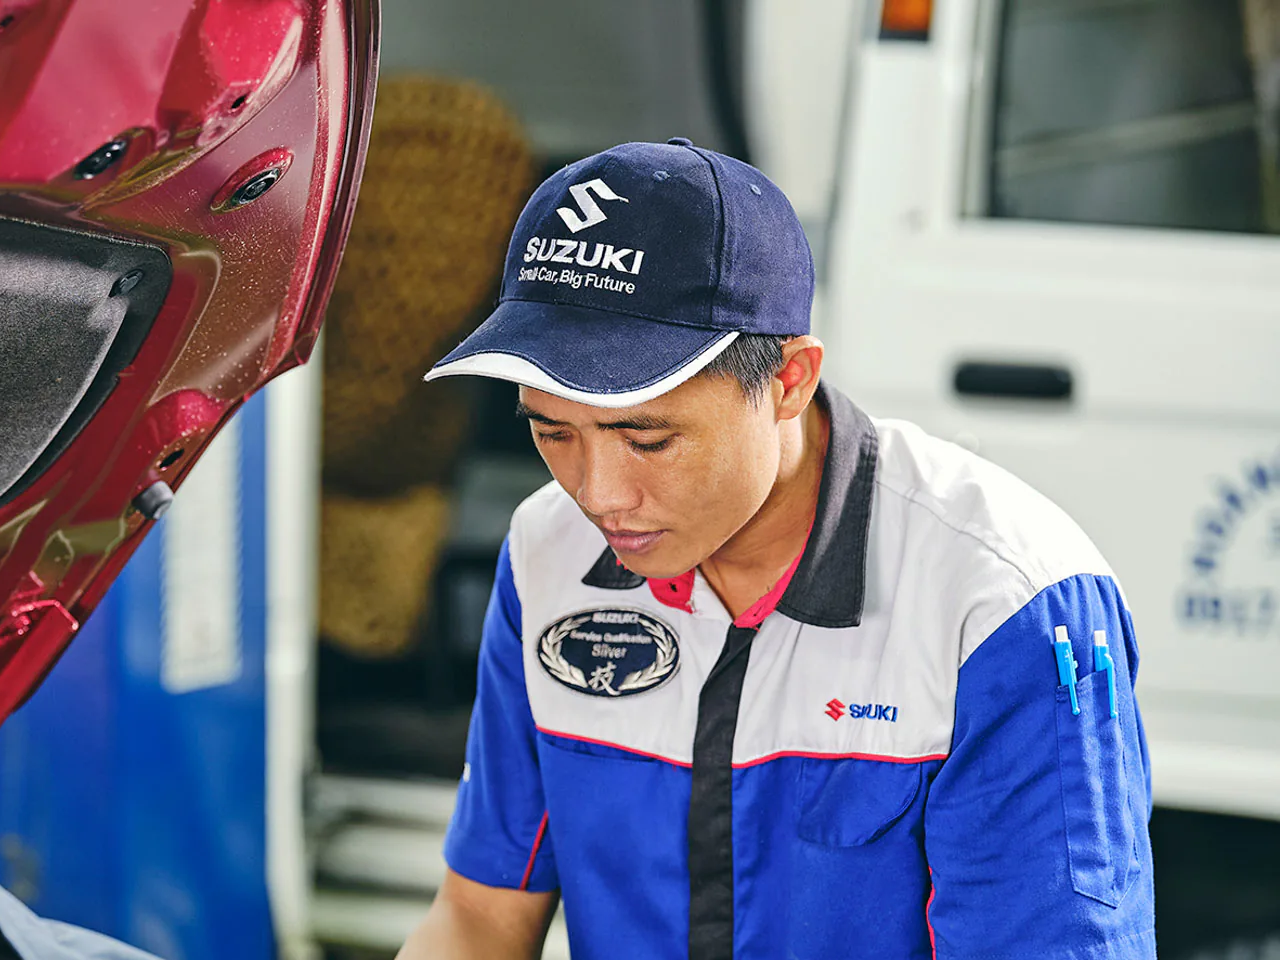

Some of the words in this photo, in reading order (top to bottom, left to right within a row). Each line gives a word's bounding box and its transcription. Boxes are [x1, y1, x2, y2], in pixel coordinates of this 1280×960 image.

[523, 236, 645, 275] SUZUKI
[559, 269, 583, 289] Big
[584, 273, 636, 294] Future
[591, 643, 627, 659] Silver
[849, 703, 899, 722] SUKI
